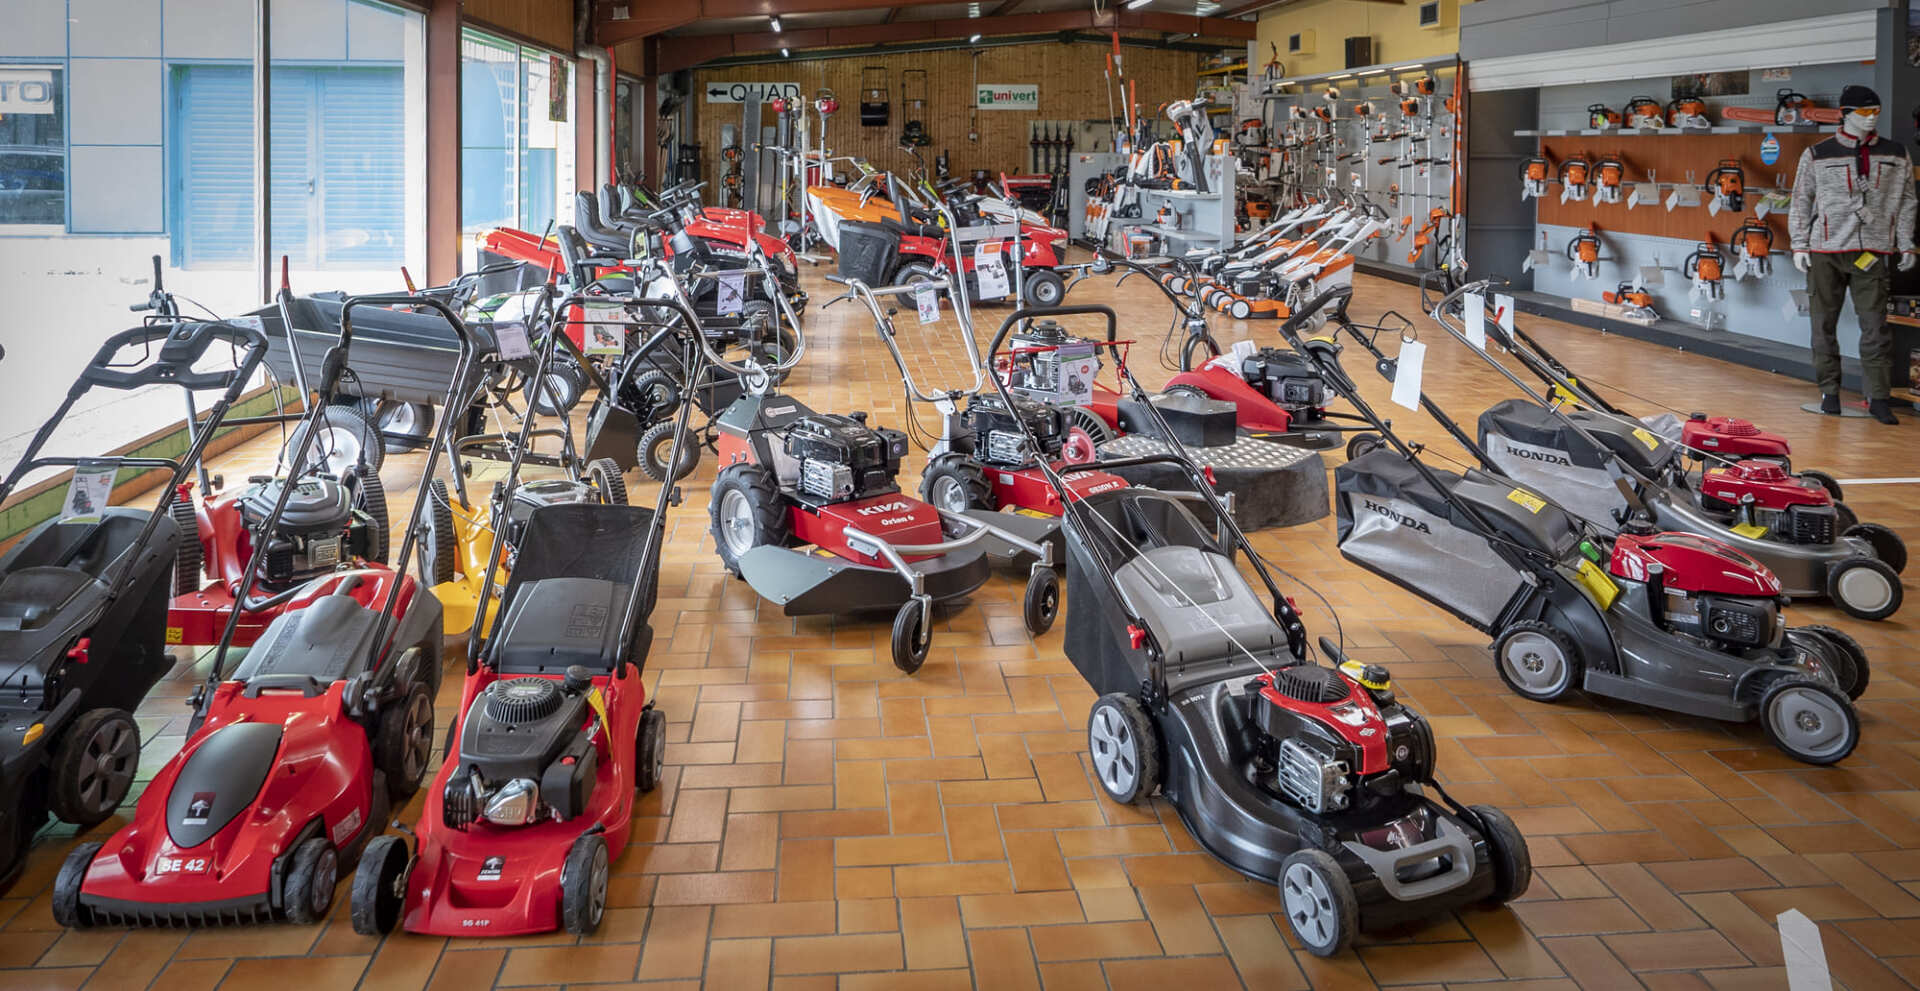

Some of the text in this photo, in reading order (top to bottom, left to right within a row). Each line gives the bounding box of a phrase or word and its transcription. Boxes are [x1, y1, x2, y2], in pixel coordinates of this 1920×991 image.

[730, 84, 799, 101] QUAD
[994, 90, 1036, 101] univert
[1506, 446, 1572, 467] HONDA
[857, 502, 908, 515] KIVA
[1365, 499, 1432, 535] HONDA
[184, 859, 205, 871] 42
